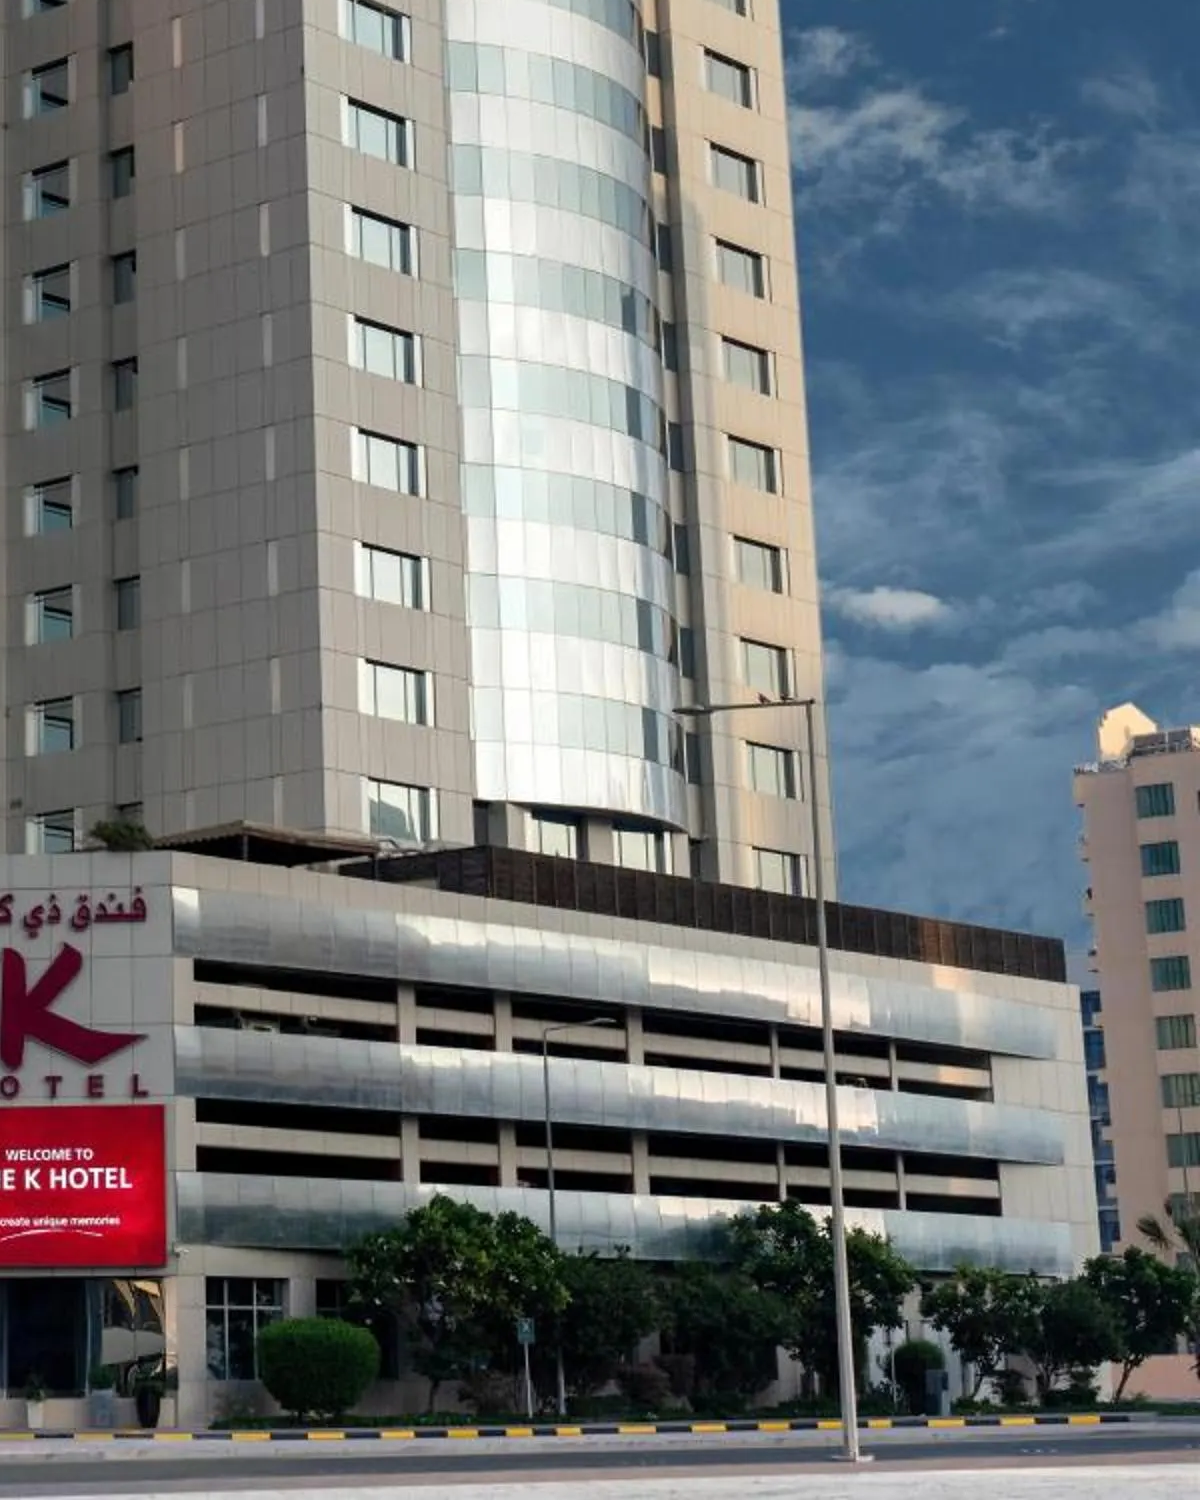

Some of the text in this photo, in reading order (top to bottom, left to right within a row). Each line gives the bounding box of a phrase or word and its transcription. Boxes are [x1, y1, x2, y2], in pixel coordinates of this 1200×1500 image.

[23, 894, 61, 939] ذي
[71, 886, 147, 932] فندق
[0, 942, 149, 1071] K
[5, 1148, 95, 1162] WELCOME TO
[24, 1168, 42, 1190] K
[49, 1167, 134, 1190] HOTEL
[0, 1217, 31, 1227] create
[32, 1215, 69, 1230] unique
[70, 1215, 121, 1226] memories
